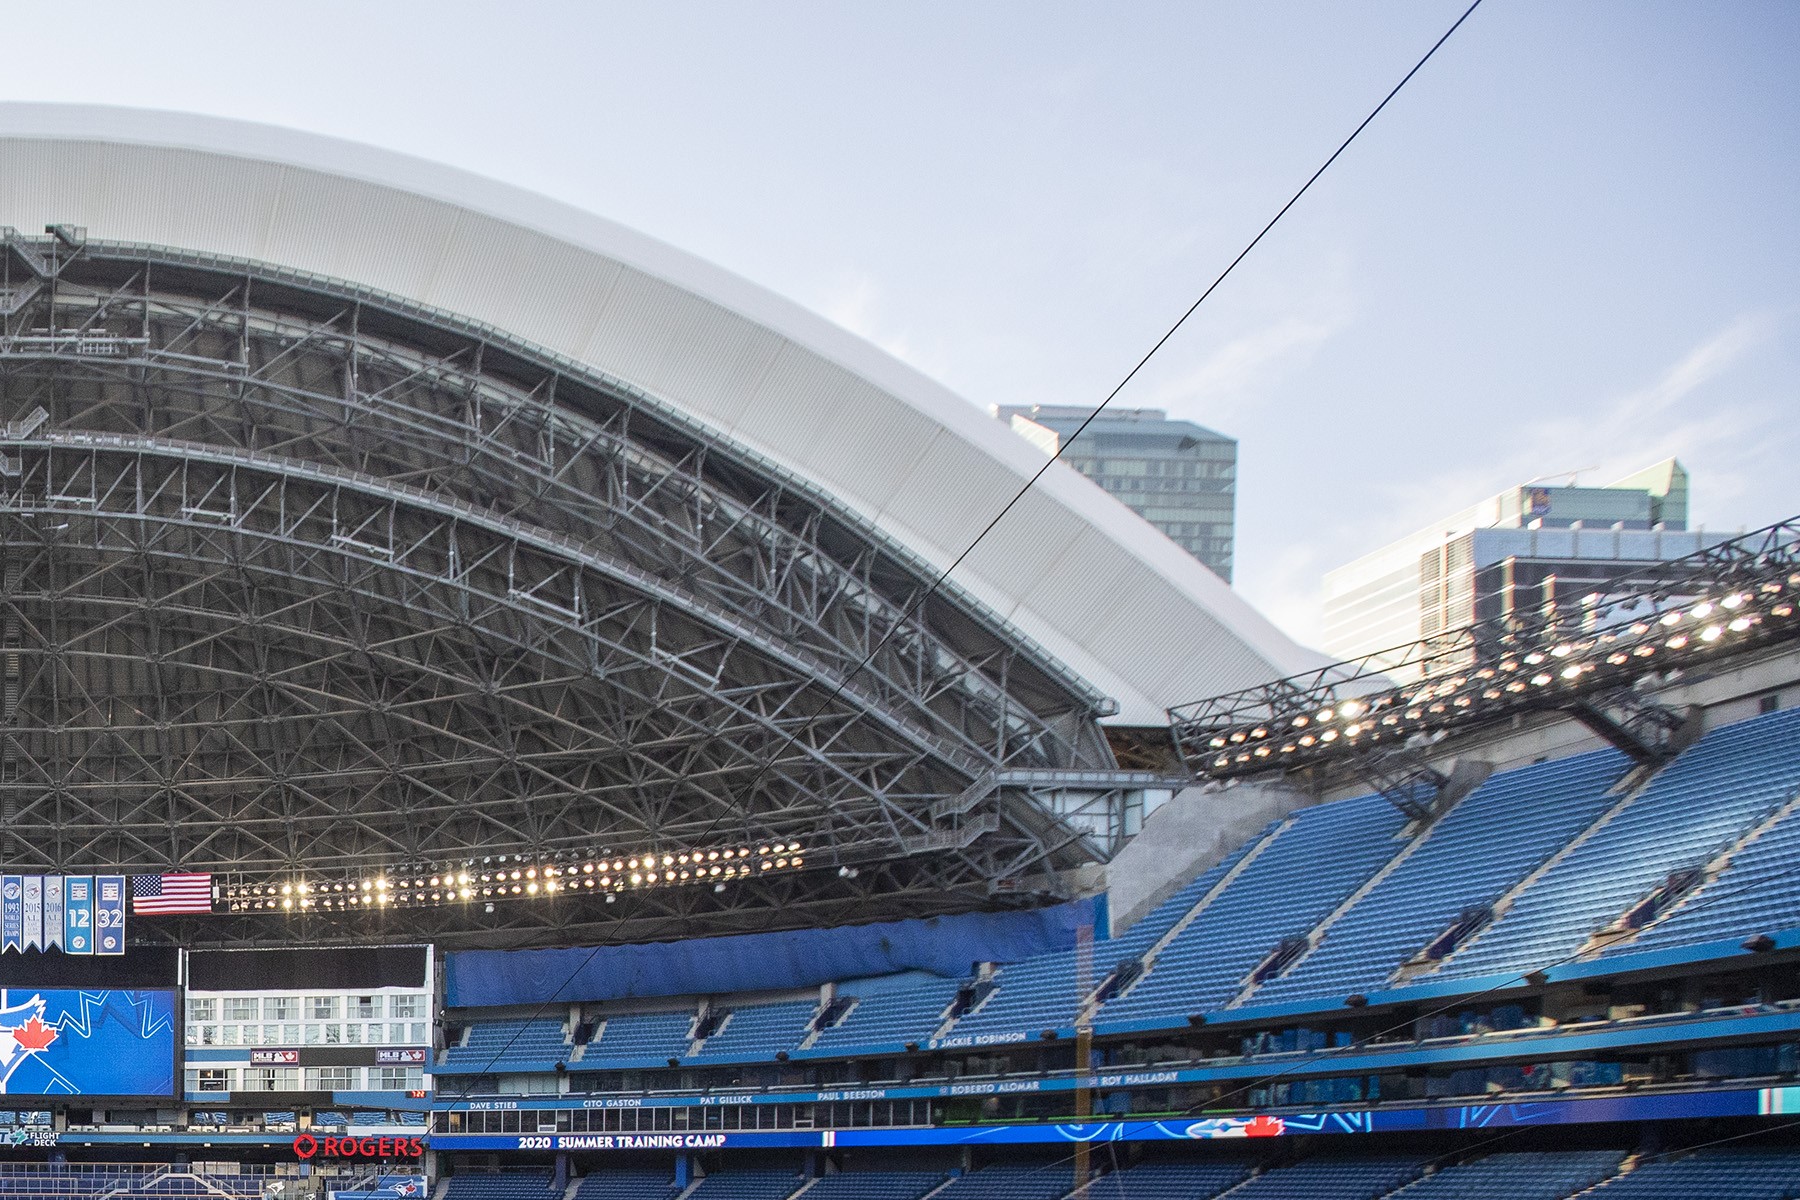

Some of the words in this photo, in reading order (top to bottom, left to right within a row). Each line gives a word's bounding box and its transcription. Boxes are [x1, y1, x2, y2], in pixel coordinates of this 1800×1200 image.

[4, 902, 20, 913] 1993
[25, 903, 41, 912] 2015
[46, 903, 61, 912] 2016
[69, 909, 89, 928] 12
[97, 909, 123, 928] 32
[940, 1036, 973, 1049] JACKIE
[974, 1032, 1027, 1046] ROBINSON
[1101, 1076, 1123, 1087] ROY
[1124, 1072, 1179, 1085] HALLADAY
[817, 1092, 840, 1101] PAUL
[843, 1089, 886, 1100] BEESTON
[951, 1083, 995, 1096] ROBERTO
[997, 1081, 1040, 1093] ALOMAR
[470, 1102, 491, 1110] DAVE
[494, 1101, 517, 1110] STIEB
[583, 1099, 603, 1108] CITO
[606, 1099, 642, 1108] GASTON
[700, 1096, 716, 1105] PAT
[719, 1095, 753, 1105] GILLICK
[324, 1137, 423, 1157] ROGERS
[518, 1137, 551, 1149] 2020
[558, 1136, 614, 1149] SUMMER
[616, 1135, 683, 1148] TRAINING
[685, 1134, 726, 1147] CAMP
